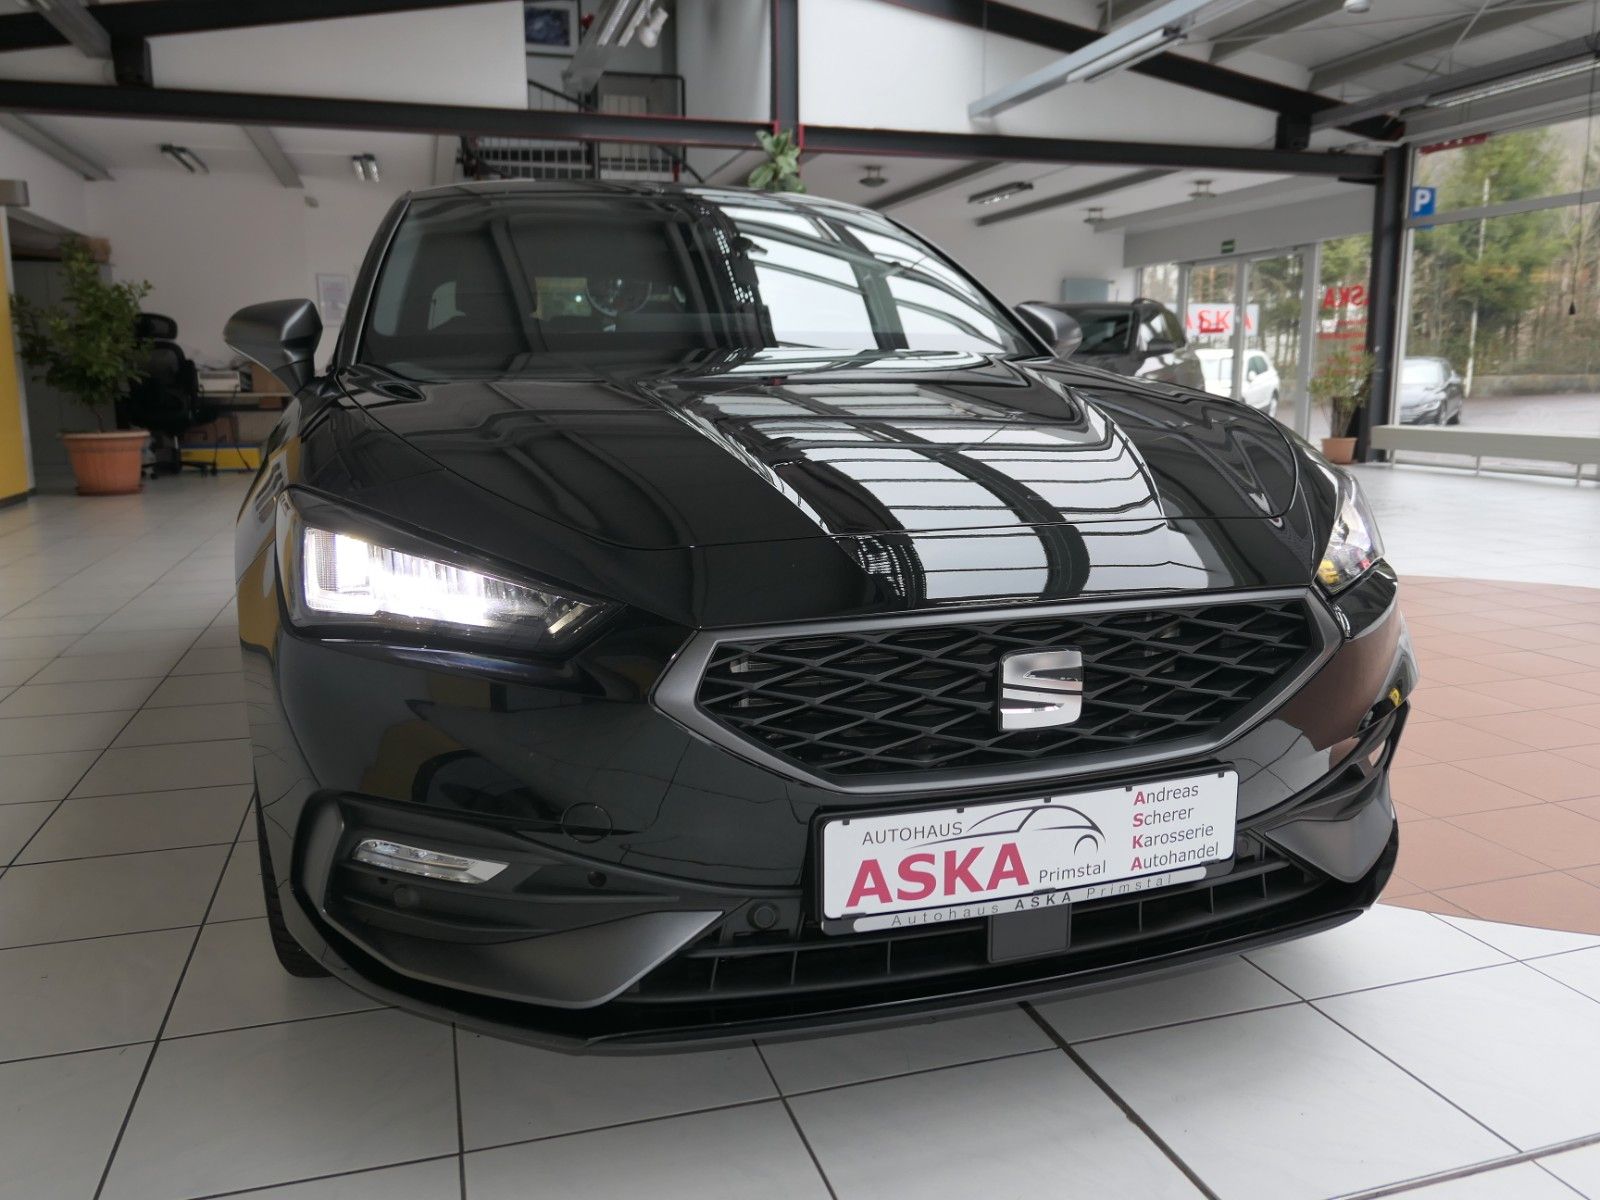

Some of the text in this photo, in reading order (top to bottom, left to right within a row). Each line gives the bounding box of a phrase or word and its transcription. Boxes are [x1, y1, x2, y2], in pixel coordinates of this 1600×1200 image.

[1414, 188, 1431, 213] P
[1133, 784, 1199, 806] Andreas
[1132, 806, 1195, 828] Scherer
[862, 821, 963, 846] AUTOHAUS
[1132, 824, 1214, 849] Karosserie
[1130, 842, 1219, 871] Autohandel
[845, 842, 1030, 908] ASKA
[1038, 860, 1106, 884] Primstal
[891, 874, 1172, 927] Autohaus ASKA Primstal
